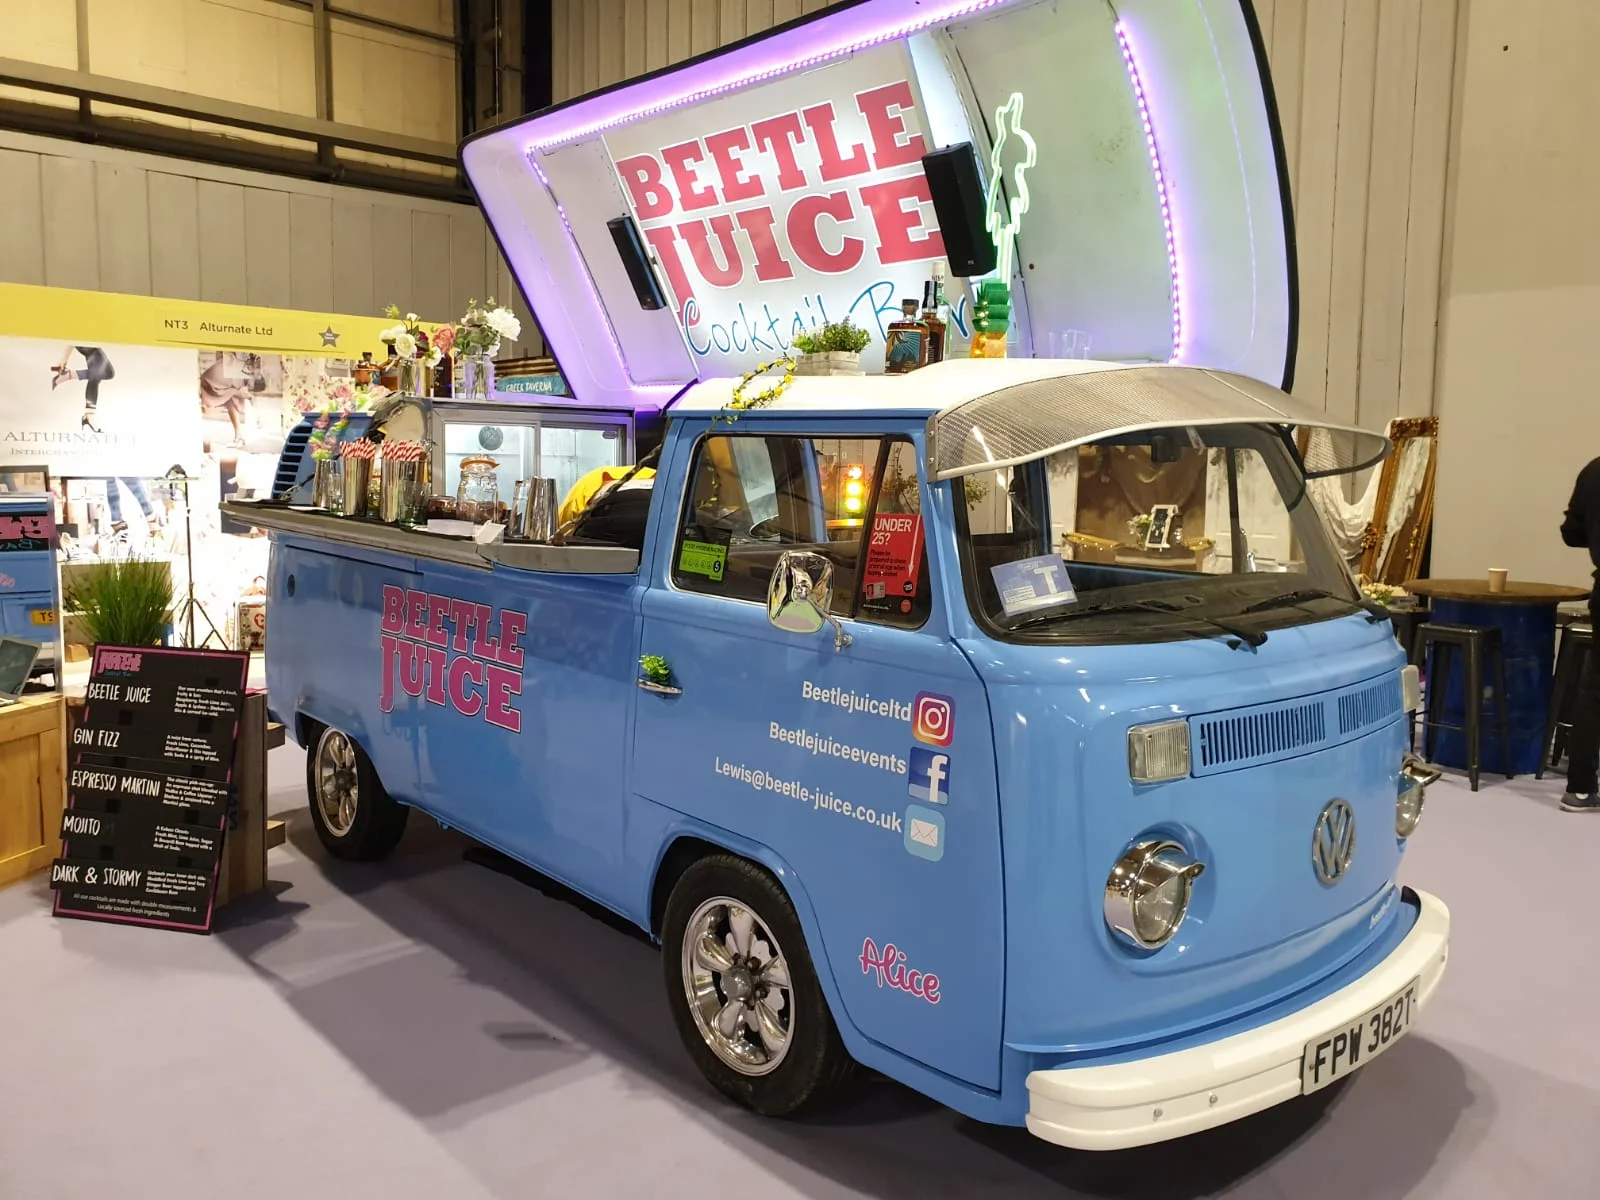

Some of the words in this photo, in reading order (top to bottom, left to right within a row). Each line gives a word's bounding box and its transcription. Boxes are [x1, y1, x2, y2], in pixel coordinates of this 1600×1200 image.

[615, 80, 927, 221] BEETLE
[644, 174, 947, 327] JUICE
[850, 281, 968, 344] Br
[164, 319, 189, 330] NT3
[200, 322, 252, 334] Alturnate
[255, 326, 273, 336] Ltd
[526, 381, 553, 392] TAVERNA
[872, 532, 891, 545] 25?
[874, 517, 913, 532] UNDER
[715, 562, 720, 572] 5
[1034, 565, 1058, 594] T
[381, 584, 528, 669] BEETLE
[88, 682, 120, 701] BEETLE
[125, 686, 152, 703] JUICE
[380, 634, 522, 733] JUICE
[802, 680, 912, 723] Beetlejuiceltd
[73, 727, 94, 745] GIN
[97, 730, 120, 748] FIZZ
[769, 721, 907, 775] Beetlejuiceevents
[71, 770, 117, 792] ESPRESSO
[121, 776, 161, 798] MARTINI
[715, 756, 902, 833] Lewis@beetle-juice.co.uk
[63, 814, 101, 836] MOJITO
[52, 865, 80, 883] DARK
[84, 866, 98, 884] &
[104, 867, 142, 887] STORMY
[859, 937, 940, 1004] Alice
[1314, 1023, 1363, 1084] FPW
[1368, 987, 1414, 1053] 382T
